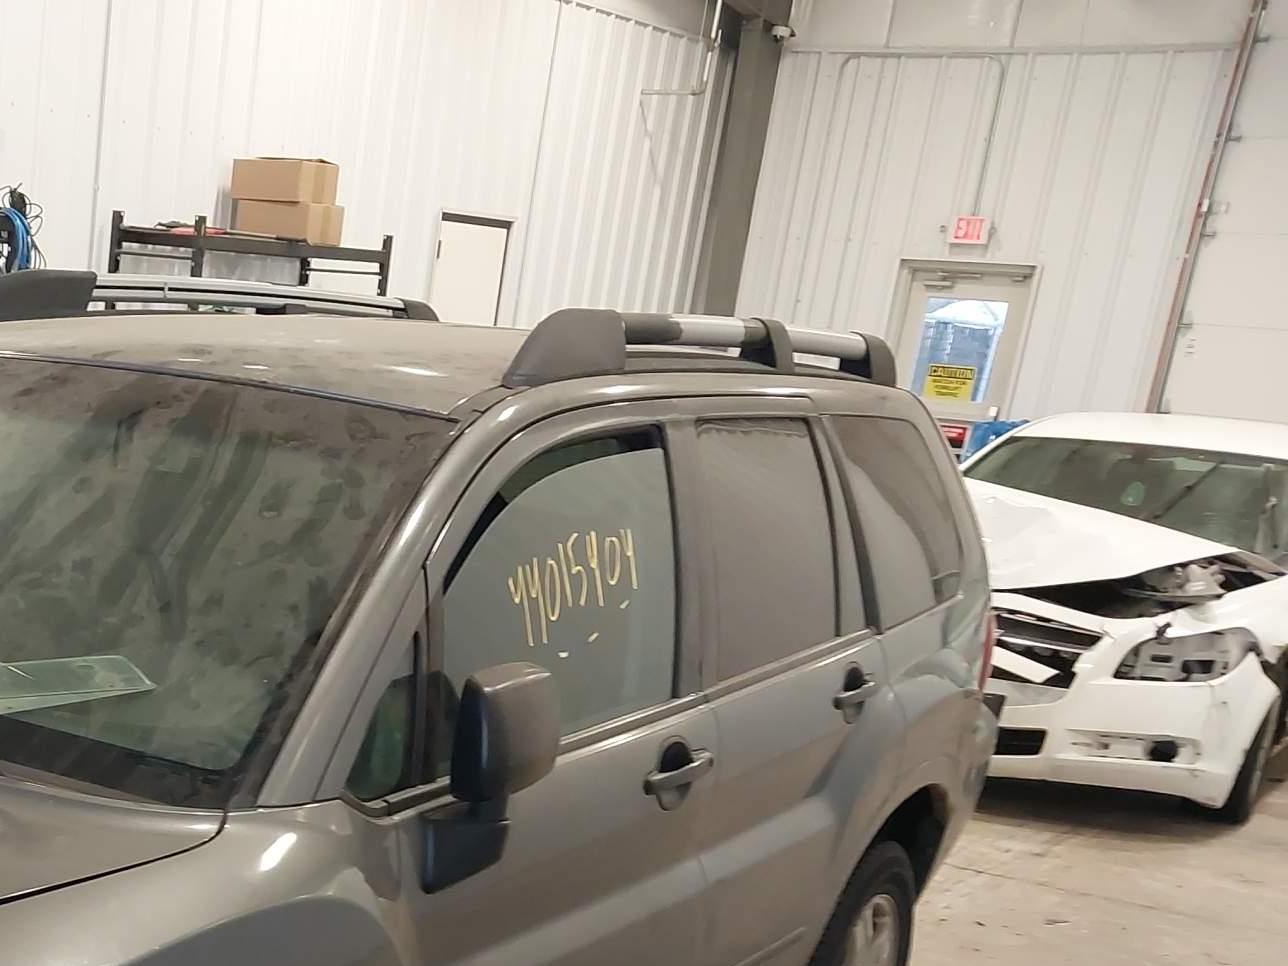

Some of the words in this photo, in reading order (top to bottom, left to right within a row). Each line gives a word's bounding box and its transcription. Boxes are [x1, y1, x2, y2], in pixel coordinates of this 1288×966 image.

[954, 219, 984, 240] EXIT
[931, 366, 974, 380] CAUTION
[507, 528, 639, 647] 44015404
